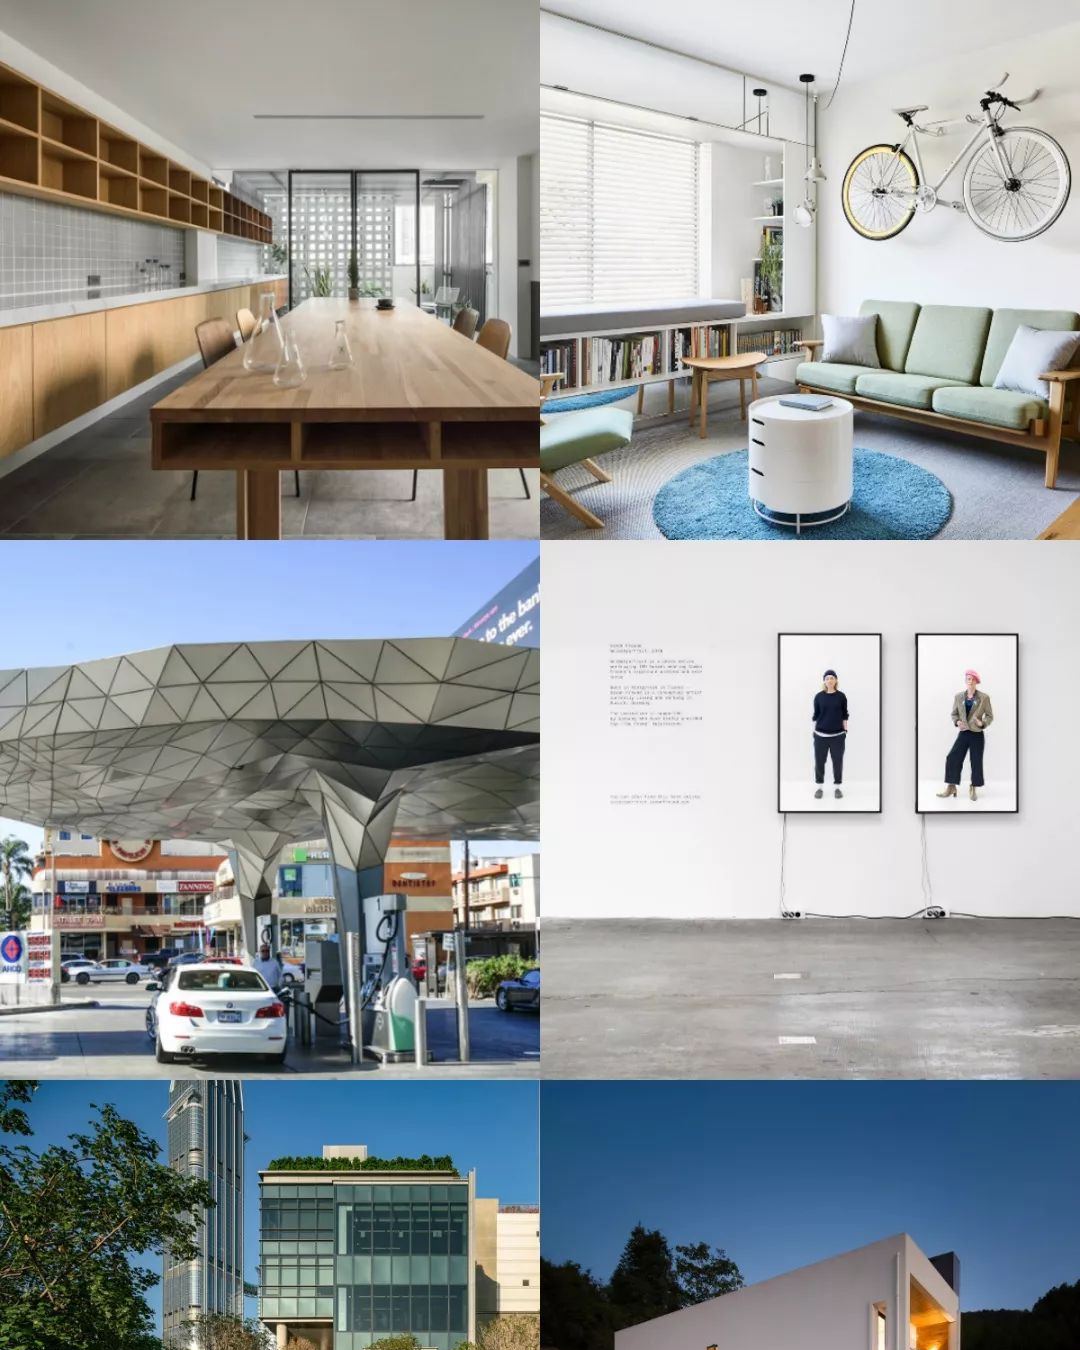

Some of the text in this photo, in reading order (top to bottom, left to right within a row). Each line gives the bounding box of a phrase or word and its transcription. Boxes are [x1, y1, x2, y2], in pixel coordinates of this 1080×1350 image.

[486, 627, 497, 642] to
[498, 611, 516, 632] the
[506, 620, 533, 646] ever.
[179, 882, 213, 891] TANNING
[392, 880, 436, 888] DENTISTRY
